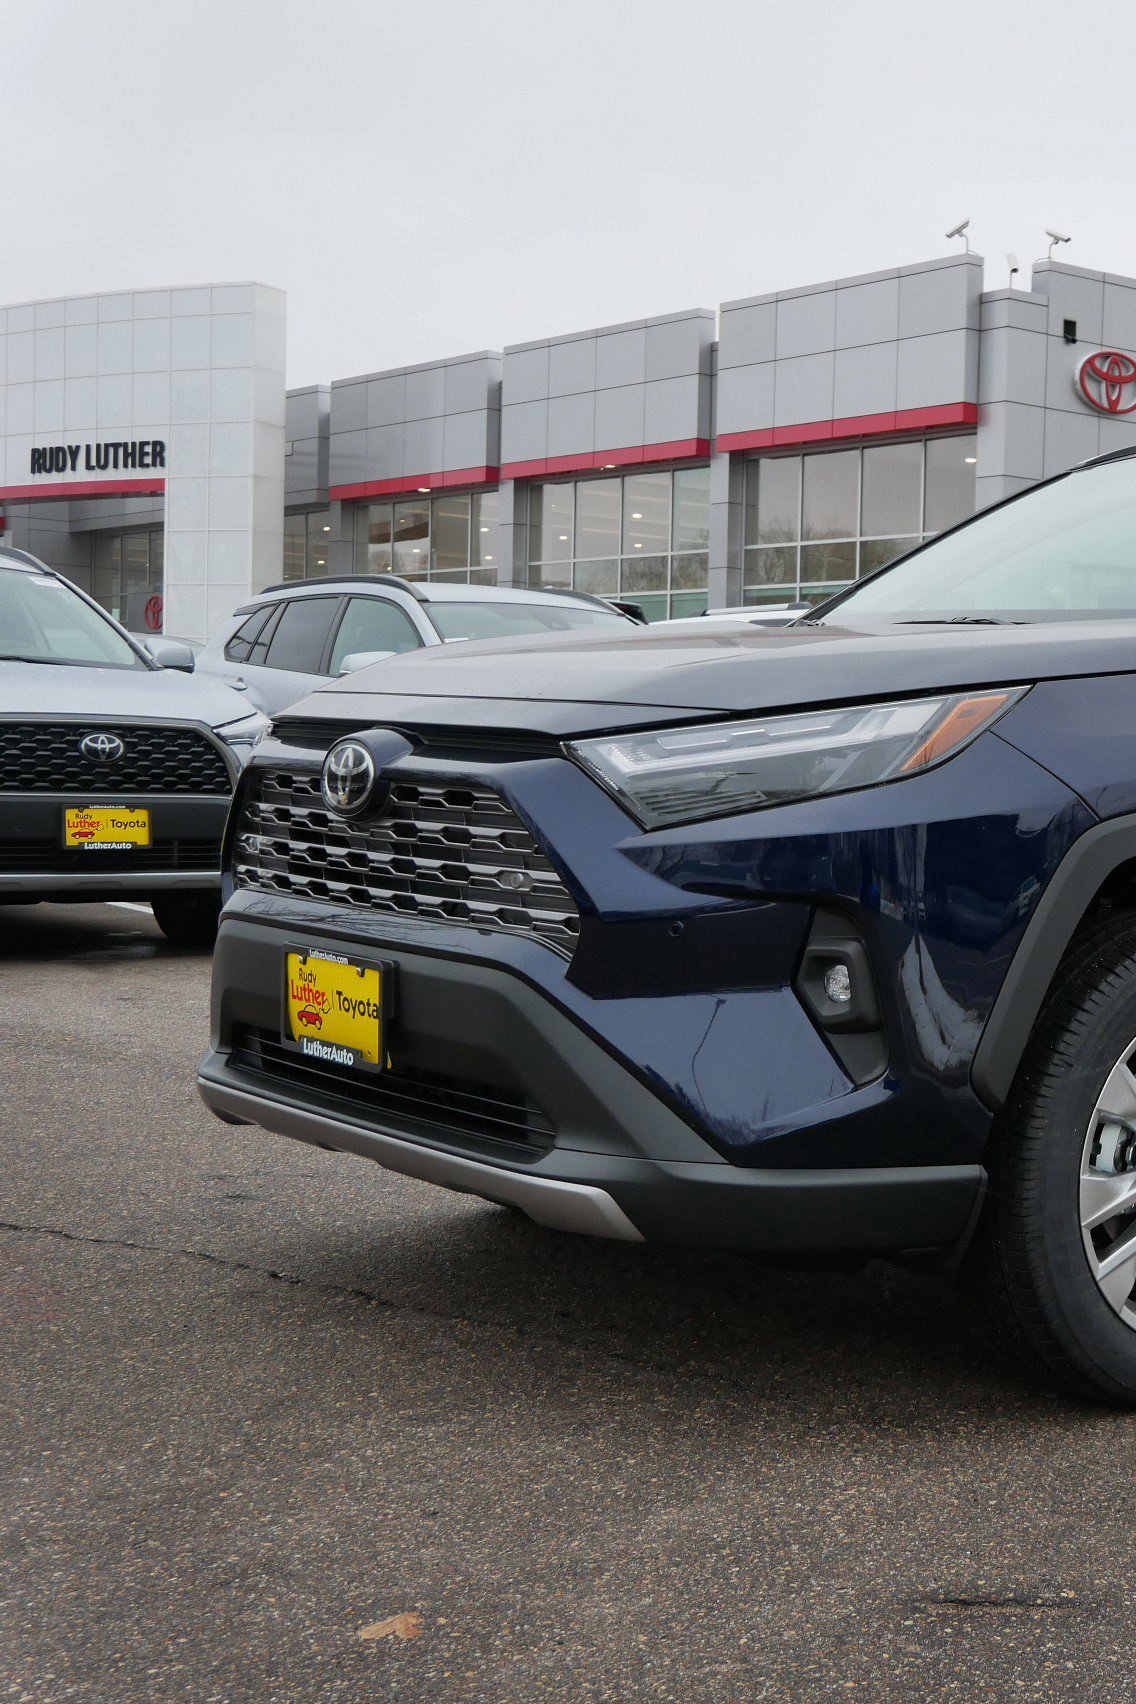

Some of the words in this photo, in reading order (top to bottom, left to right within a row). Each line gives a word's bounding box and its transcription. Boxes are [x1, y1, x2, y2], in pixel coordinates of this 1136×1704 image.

[30, 444, 81, 474] RUDY
[85, 440, 166, 471] LUTHER
[67, 819, 101, 829] Luther
[110, 819, 146, 830] Toyota
[84, 842, 132, 850] LutherAuto
[298, 967, 317, 987] Rudy
[291, 979, 326, 1007] Luther
[335, 990, 379, 1020] Toyota
[303, 1037, 354, 1066] LutherAuto
